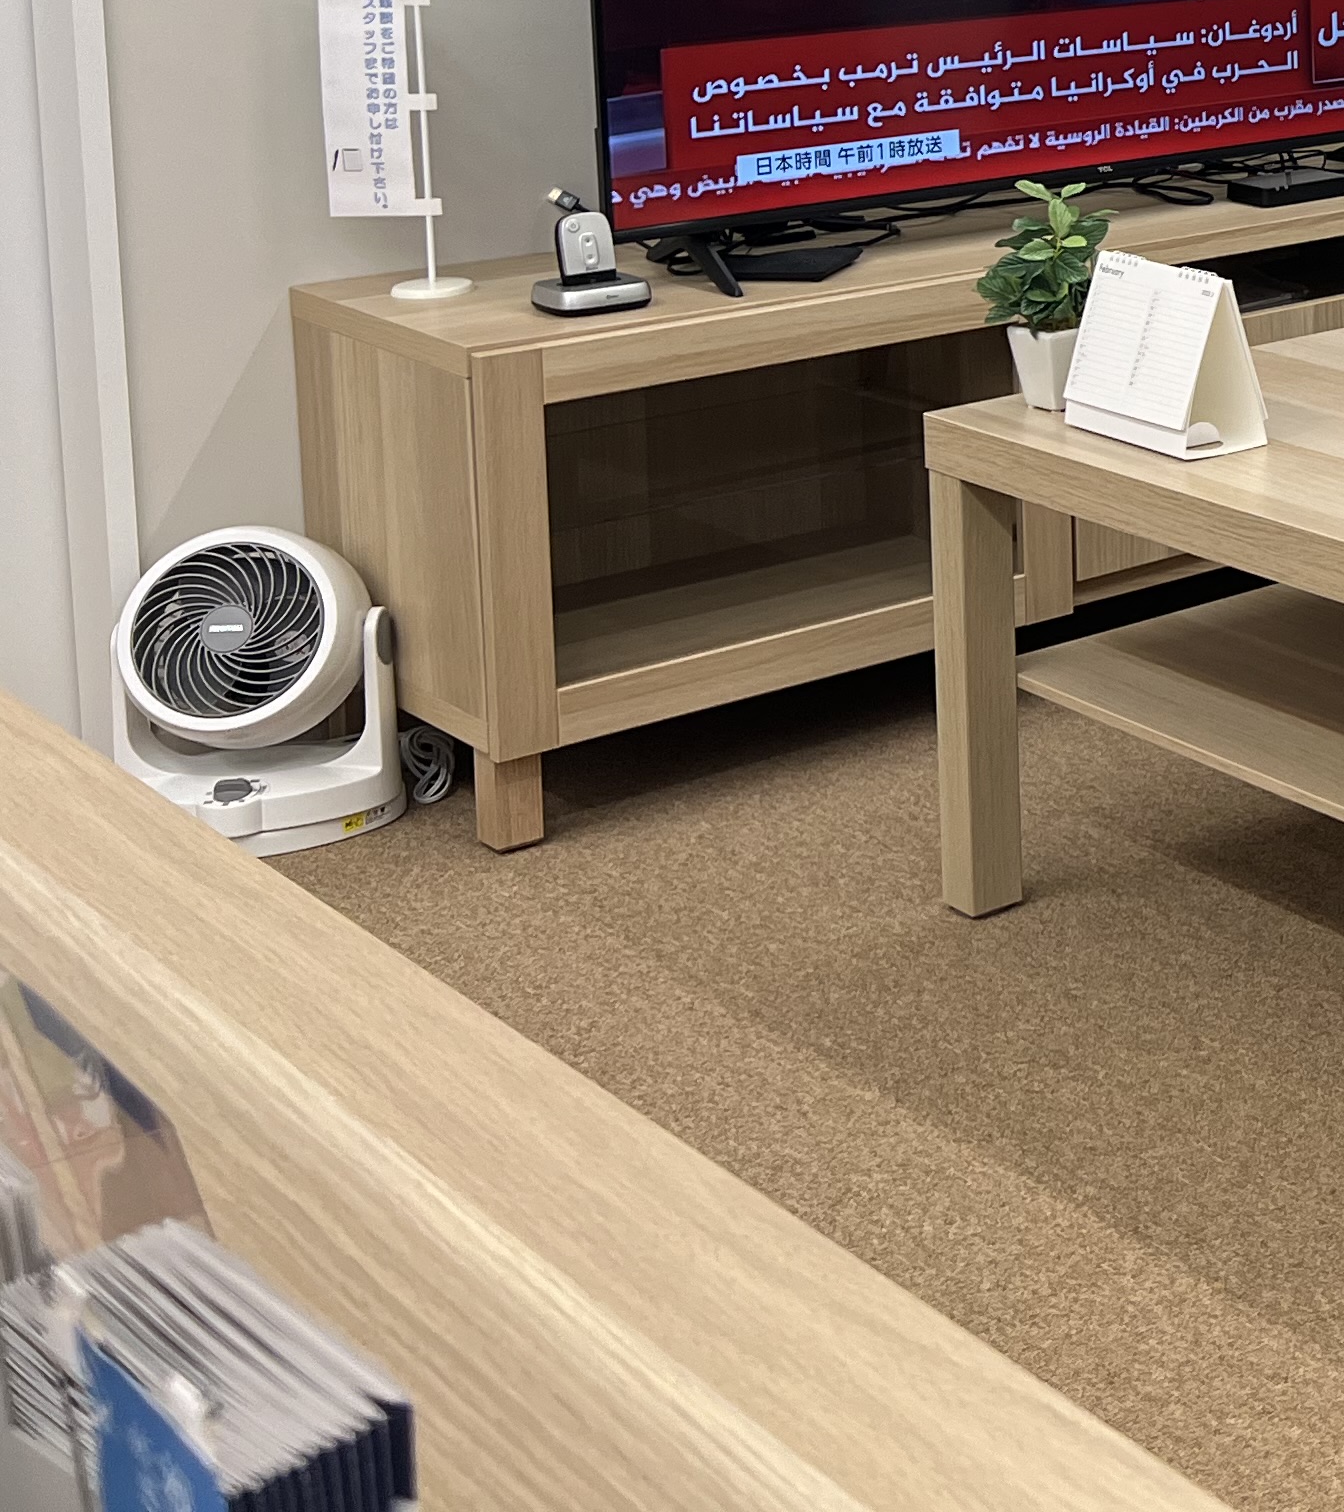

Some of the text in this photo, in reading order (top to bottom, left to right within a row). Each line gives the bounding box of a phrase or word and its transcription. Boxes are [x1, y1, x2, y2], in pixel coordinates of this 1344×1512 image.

[756, 147, 832, 176] 日本時間
[837, 136, 943, 166] 午前1時放送
